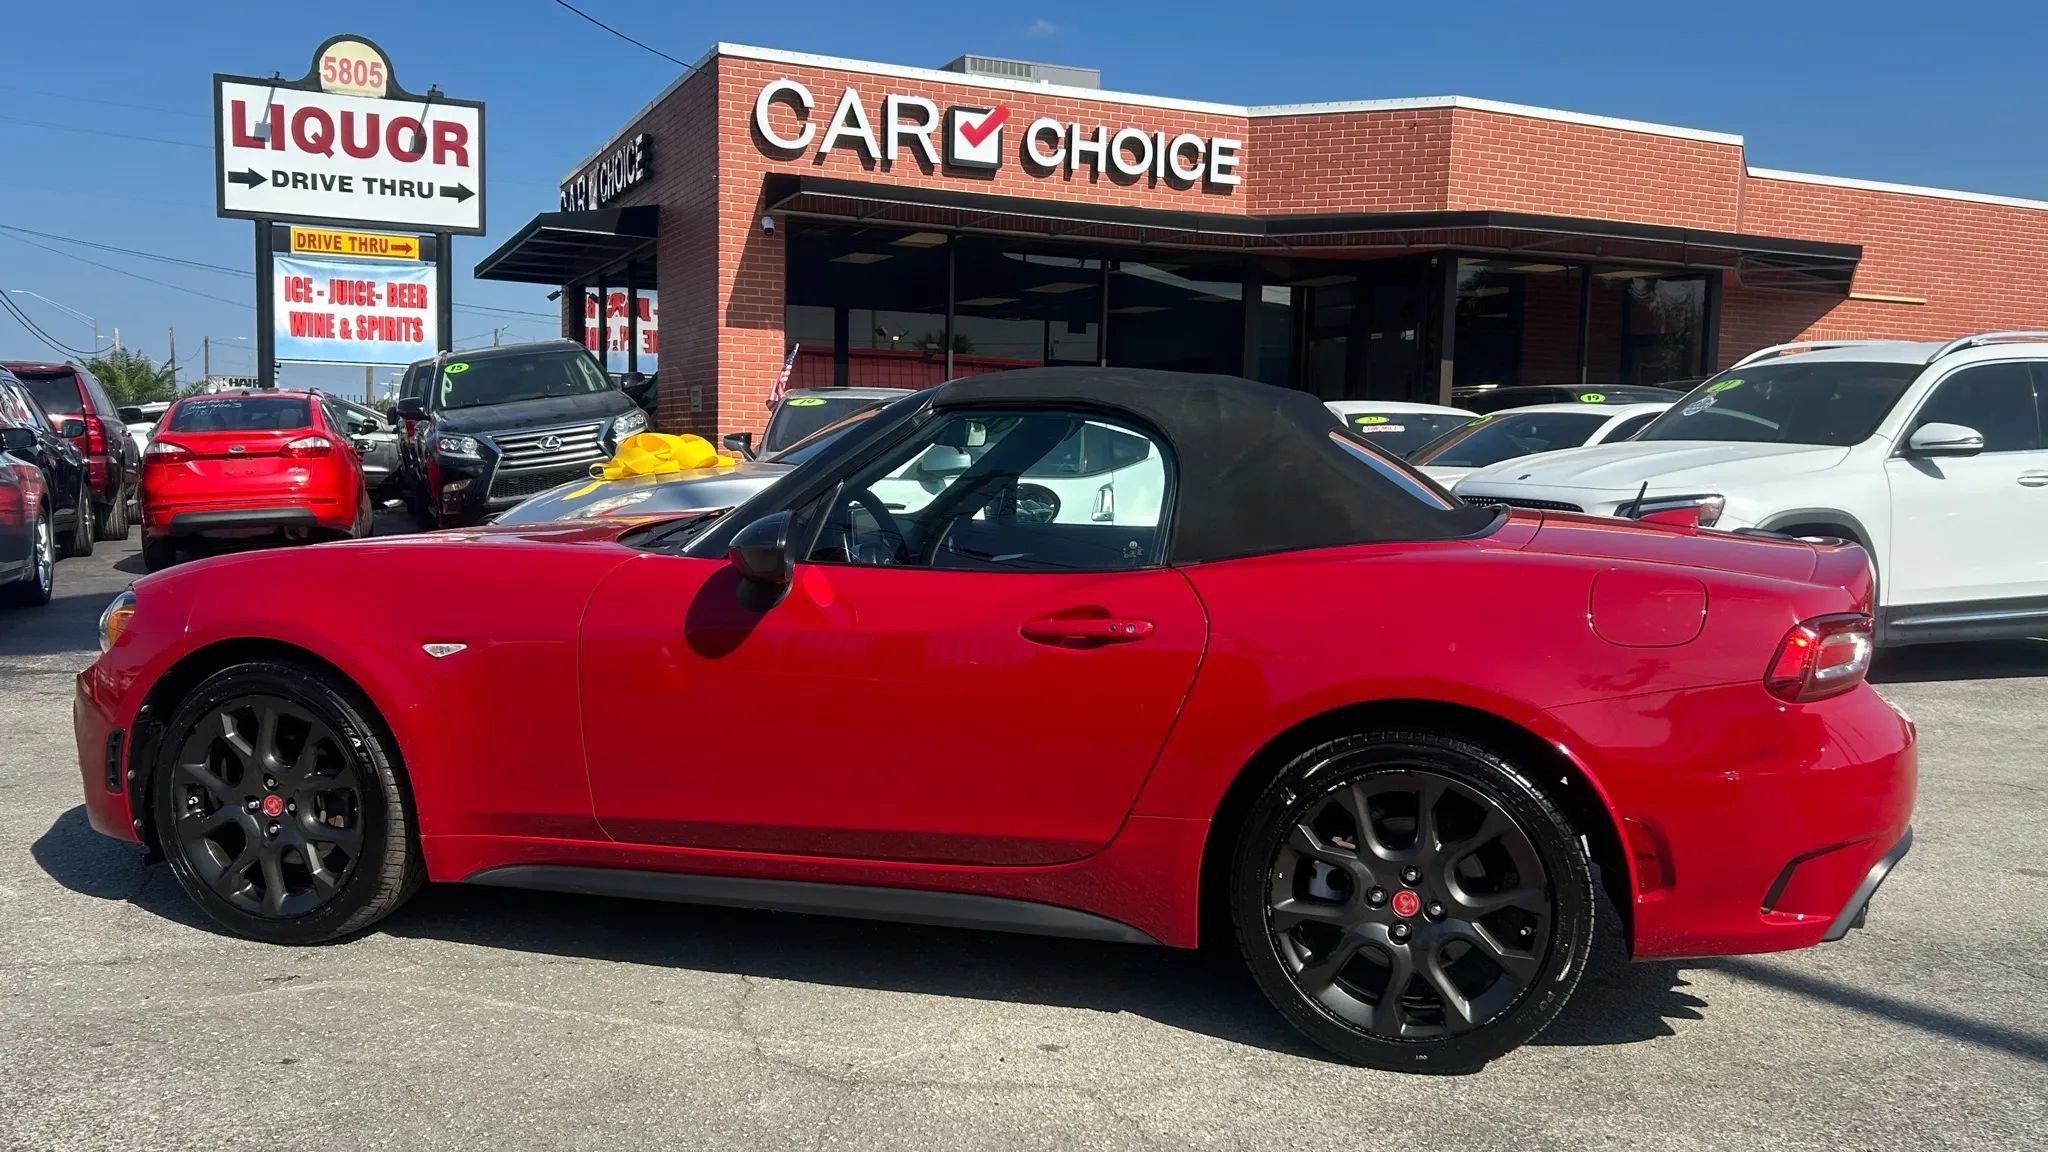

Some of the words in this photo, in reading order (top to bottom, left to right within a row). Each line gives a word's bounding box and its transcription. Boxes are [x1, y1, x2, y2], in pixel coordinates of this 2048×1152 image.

[322, 55, 383, 88] 5805
[231, 99, 470, 167] LIQUOR
[755, 78, 941, 164] CAR
[1026, 116, 1242, 185] CHOICE
[271, 169, 353, 193] DRIVE
[362, 177, 434, 199] THRU
[600, 133, 643, 203] CHOICE
[296, 232, 342, 251] DRIVE
[348, 236, 389, 254] THRU
[284, 275, 313, 303] ICE
[386, 282, 428, 309] BEER
[289, 311, 335, 339] WINE
[339, 317, 352, 340] &
[355, 314, 424, 343] SPIRITS
